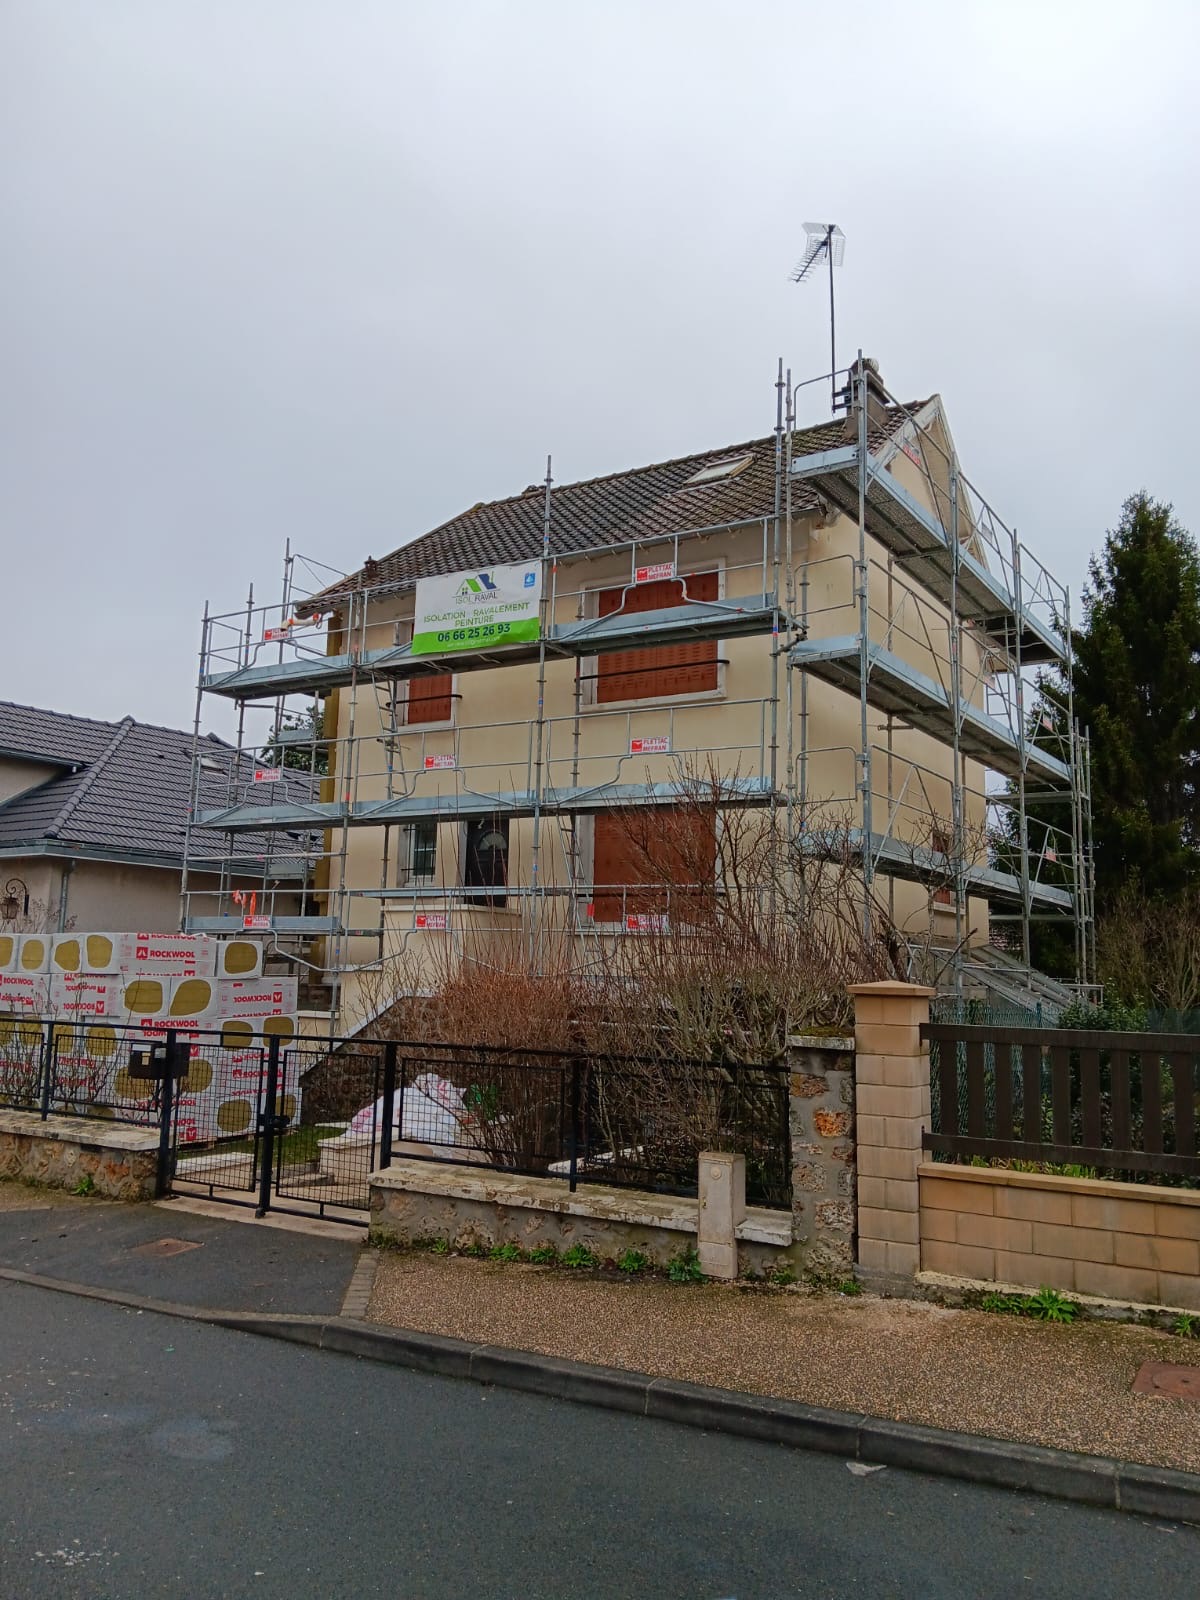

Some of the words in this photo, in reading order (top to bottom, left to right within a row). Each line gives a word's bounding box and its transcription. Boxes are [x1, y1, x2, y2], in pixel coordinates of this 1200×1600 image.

[423, 610, 466, 623] ISOLATION
[473, 602, 530, 616] RAVALEMENT
[455, 615, 494, 627] PEINTURE
[437, 632, 450, 642] 06
[453, 630, 466, 641] 66
[468, 628, 480, 639] 25
[482, 625, 495, 636] 26
[497, 623, 511, 634] 93
[150, 950, 195, 958] ROCKWOOL
[3, 976, 34, 986] ROCKWOOL
[234, 994, 272, 1003] ROCKWOOL
[154, 1020, 199, 1028] ROCKWOOL
